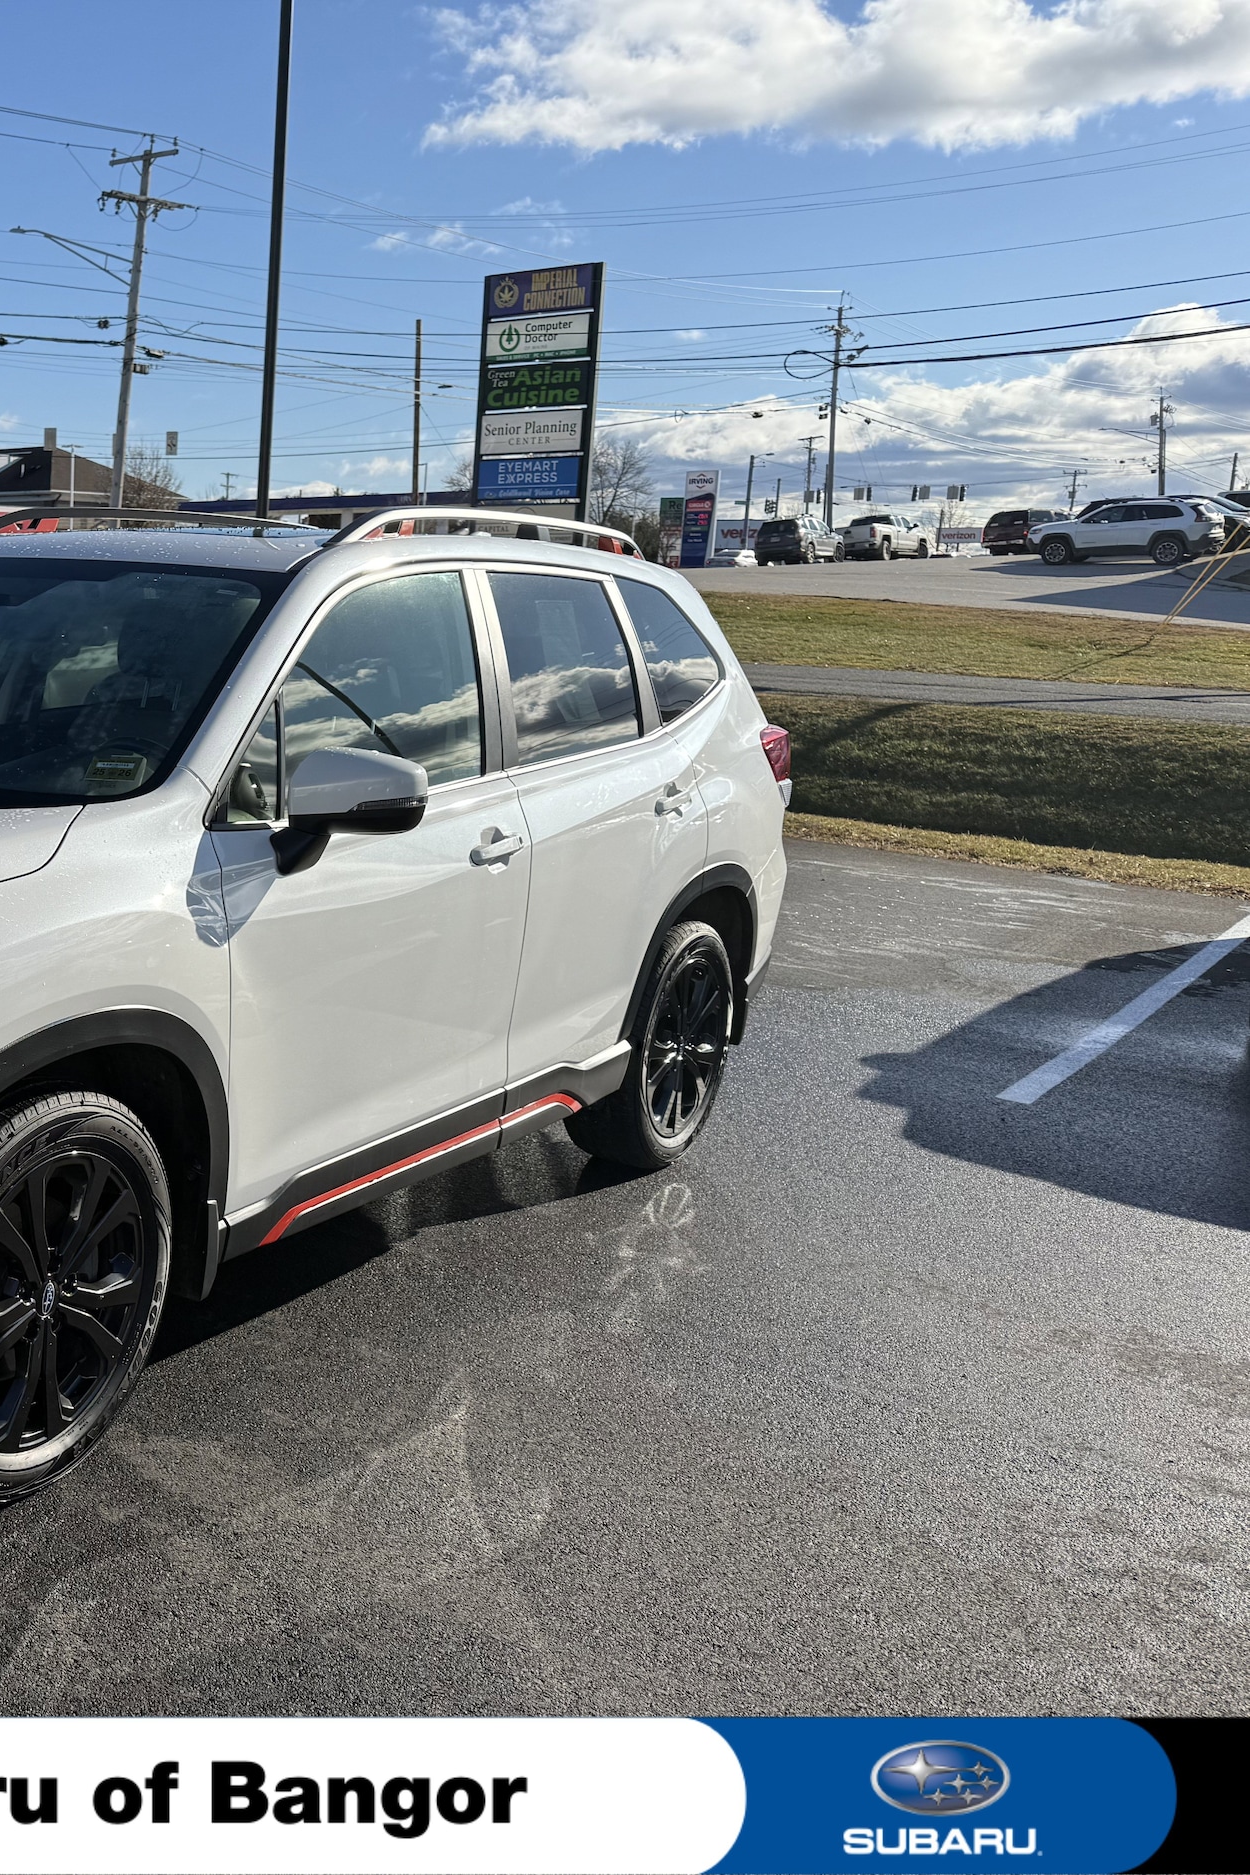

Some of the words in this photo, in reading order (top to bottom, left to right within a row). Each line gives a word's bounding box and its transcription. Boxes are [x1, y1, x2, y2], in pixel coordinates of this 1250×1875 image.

[531, 268, 578, 292] IMPERIAL
[523, 286, 586, 311] CONNECTION
[525, 320, 573, 335] Computer
[524, 332, 558, 344] Doctor
[488, 370, 516, 380] Green
[512, 366, 582, 386] Asian
[492, 378, 509, 388] Tea
[487, 386, 580, 407] Cuisine
[484, 423, 521, 437] Senior
[525, 420, 577, 436] Planning
[508, 436, 551, 446] CENTER
[498, 460, 559, 473] EYEMART
[497, 472, 558, 484] EXPRESS
[688, 477, 714, 485] IRVING
[941, 531, 976, 540] verizon
[92, 768, 105, 776] 25
[117, 769, 132, 777] 26
